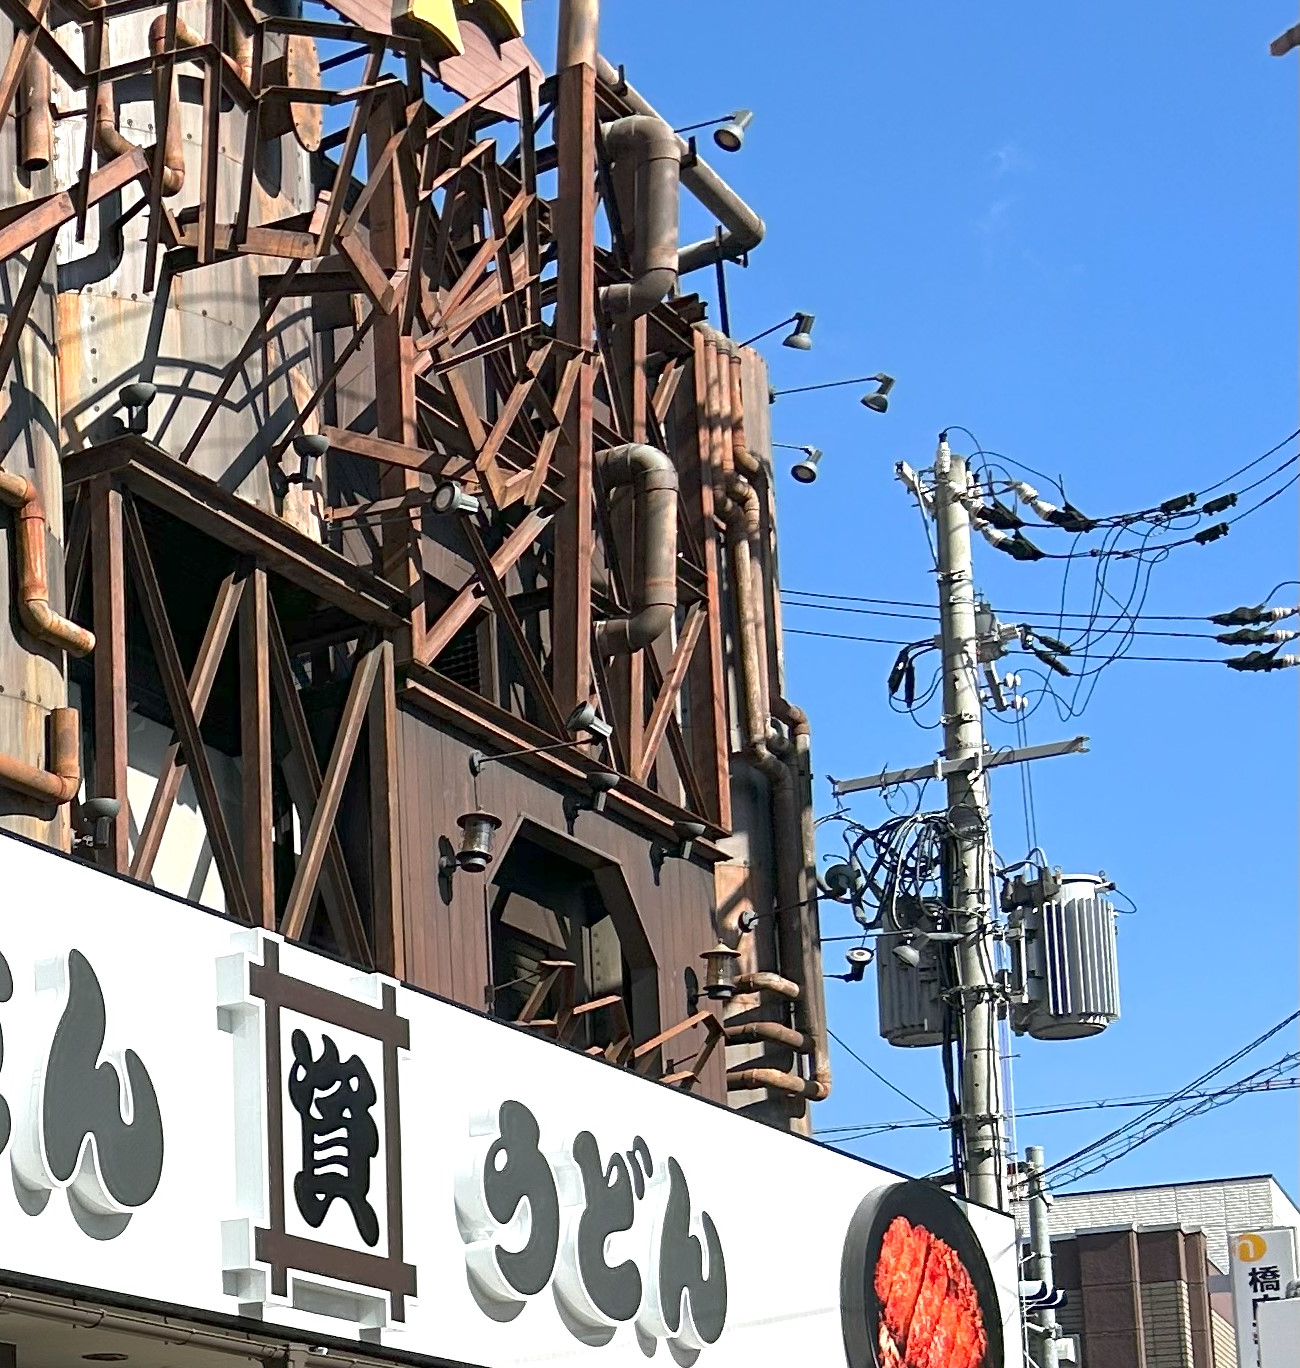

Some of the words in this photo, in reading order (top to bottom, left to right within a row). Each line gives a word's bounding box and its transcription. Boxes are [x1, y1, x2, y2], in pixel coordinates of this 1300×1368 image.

[289, 1027, 380, 1247] 資
[490, 1098, 728, 1344] うどん
